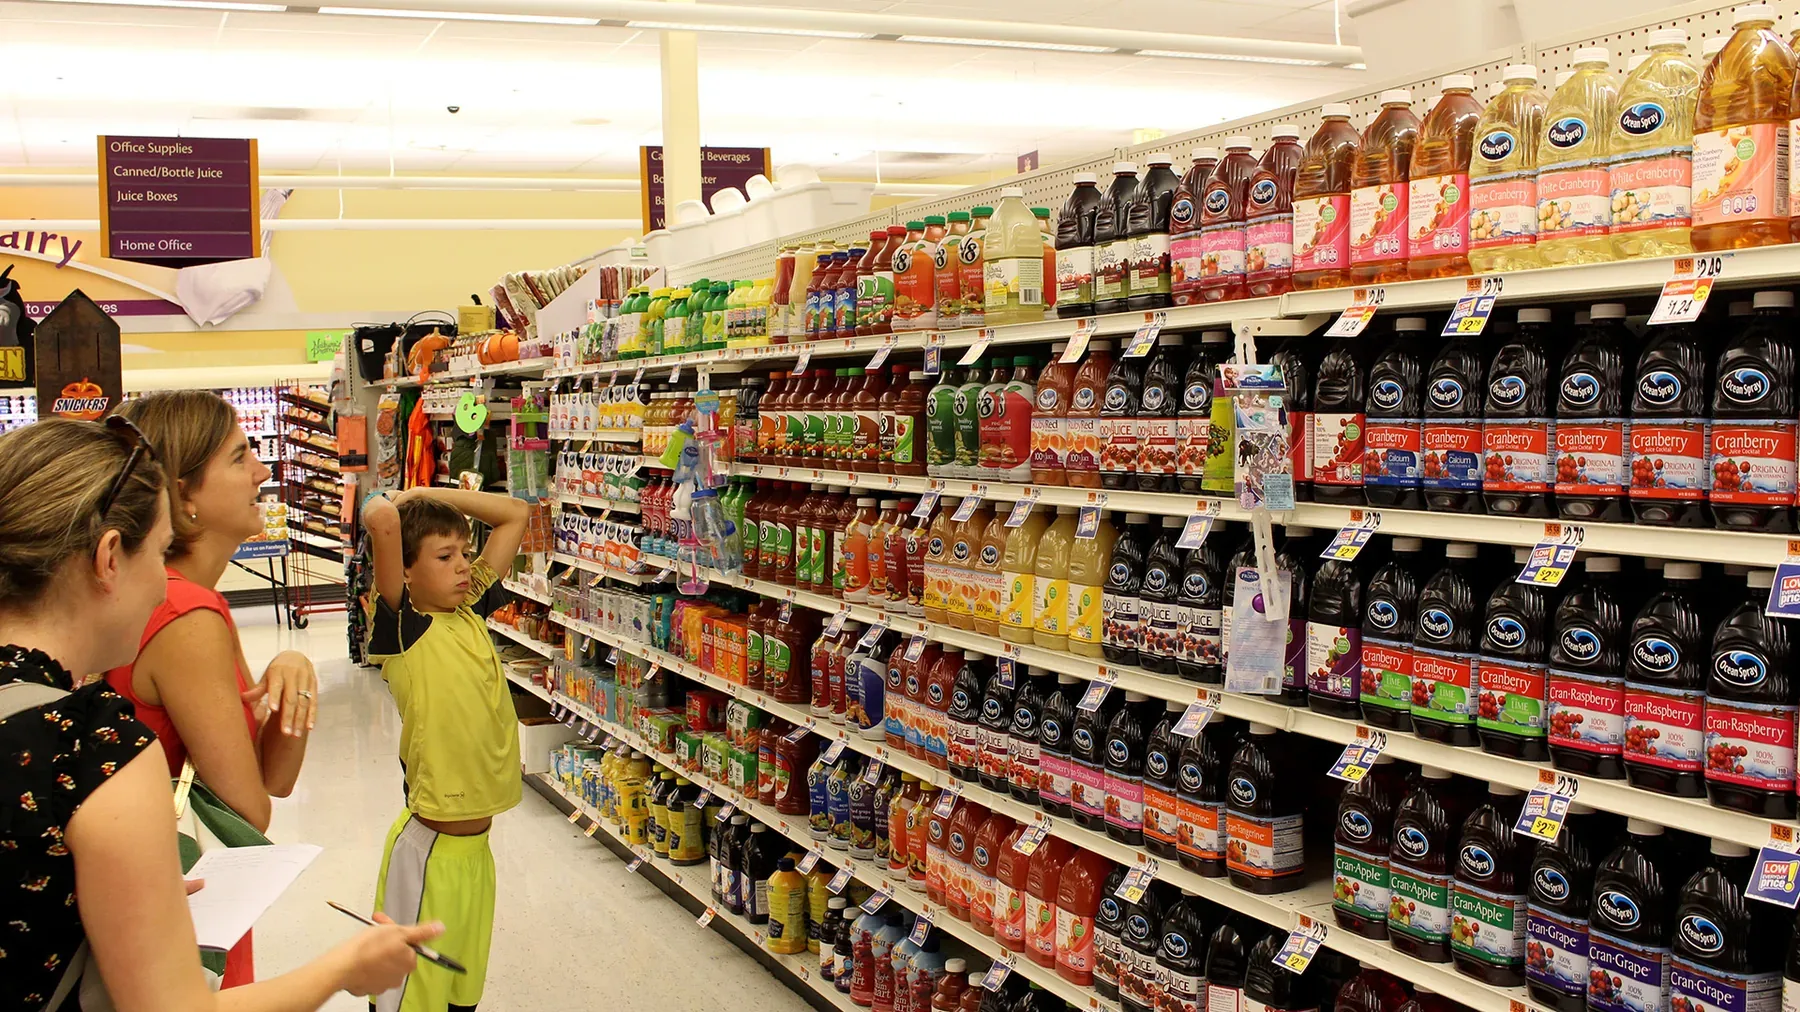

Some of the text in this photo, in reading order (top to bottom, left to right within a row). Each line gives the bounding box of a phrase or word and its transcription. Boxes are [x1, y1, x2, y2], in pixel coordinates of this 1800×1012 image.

[1622, 112, 1658, 129] Ocean Spray
[1550, 128, 1582, 142] Ocean Spray
[111, 142, 192, 155] Office Supplies
[1482, 141, 1510, 156] Ocean Spray
[708, 152, 750, 164] Beverages
[114, 166, 222, 179] Canned/Bottle Juice
[701, 175, 716, 184] ater
[1610, 170, 1634, 186] White
[1636, 166, 1684, 182] Cranberry
[1538, 176, 1602, 194] White Cranberry
[117, 190, 178, 202] Juice Boxes
[1470, 189, 1530, 205] White Cranberry
[0, 231, 82, 269] airy
[120, 240, 192, 250] Home Office
[26, 304, 39, 314] to
[1667, 300, 1692, 316] $1.24
[1492, 386, 1520, 400] Ocean Spray
[1564, 383, 1594, 398] Ocean Spray
[1642, 382, 1674, 398] Ocean Spray
[1726, 378, 1762, 396] Ocean Spray
[54, 398, 106, 411] SNICKERS
[1367, 430, 1408, 448] Cranberry
[1426, 431, 1469, 449] Cranberry
[1486, 430, 1533, 450] Cranberry
[1558, 430, 1608, 450] Cranberry
[1632, 432, 1688, 453] Cranberry
[1716, 432, 1779, 456] Cranberry
[1388, 454, 1410, 462] Calcium
[1448, 456, 1471, 464] Calcium
[1512, 458, 1541, 466] ORIGINAL
[1586, 458, 1616, 467] ORIGINAL
[1664, 460, 1696, 470] ORIGINAL
[1751, 464, 1788, 474] ORIGINAL
[1780, 594, 1800, 604] pric
[1370, 608, 1393, 622] Ocean Spray
[1423, 618, 1448, 634] Ocean Spray
[1490, 624, 1520, 642] Ocean Spray
[1564, 636, 1594, 655] Ocean Spray
[1362, 650, 1402, 670] Cranberry
[1637, 648, 1672, 666] Ocean Spray
[1414, 660, 1458, 682] Cranberry
[1720, 660, 1758, 681] Ocean Spray
[1386, 675, 1400, 686] LIME
[1481, 670, 1532, 694] Cranberry
[1440, 688, 1456, 698] LIME
[1511, 701, 1528, 712] LIME
[1590, 718, 1606, 726] 100%
[1668, 733, 1684, 742] 100%
[1755, 750, 1774, 760] 100%
[1773, 826, 1790, 839] $4.98
[1400, 834, 1424, 852] Ocean Spray
[1462, 852, 1489, 871] Ocean Spray
[1764, 863, 1788, 874] LOW
[1537, 874, 1564, 894] Ocean Spray
[1601, 898, 1633, 920] Ocean Spray
[1484, 929, 1497, 938] 100%
[1684, 922, 1717, 946] Ocean Spray
[1628, 984, 1642, 996] 100%
